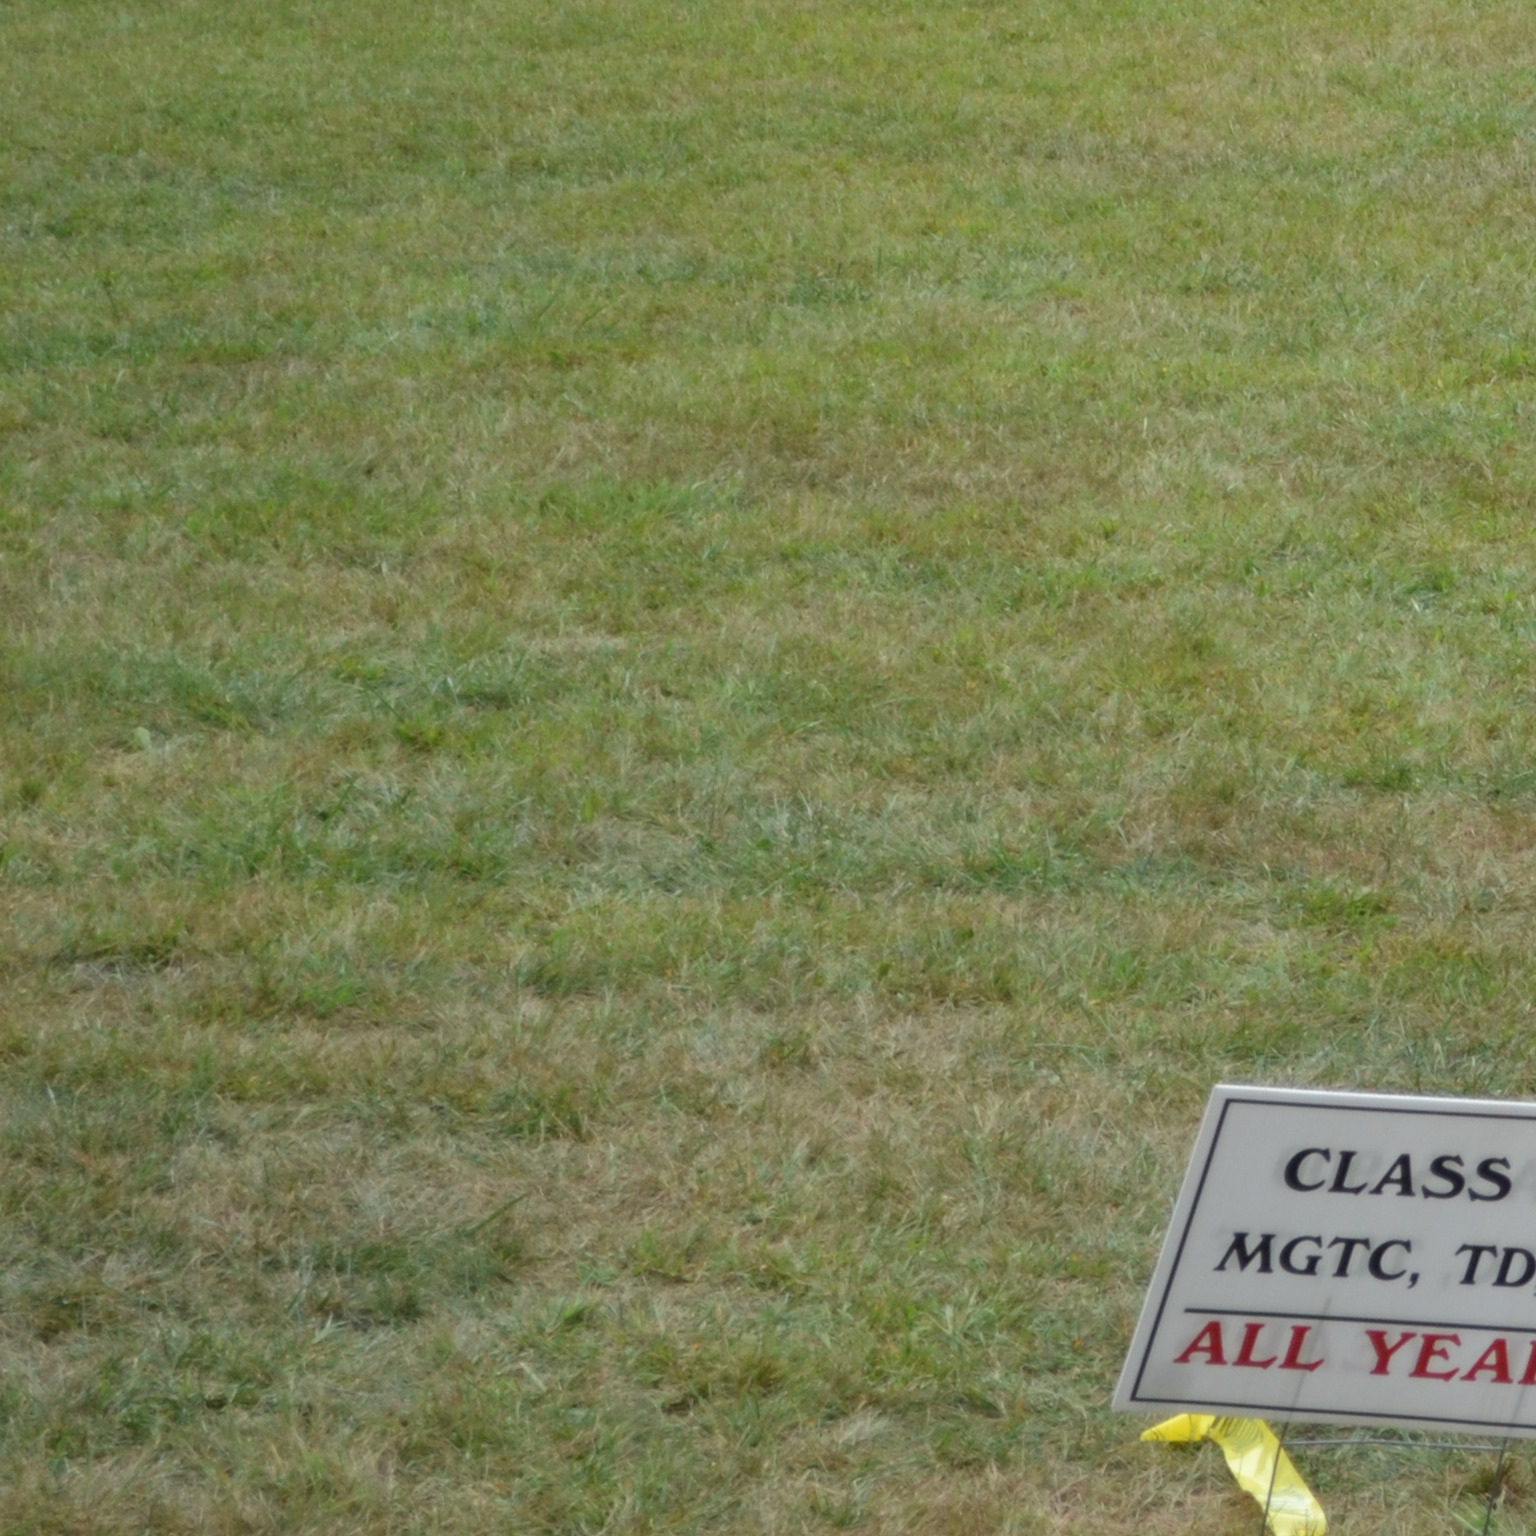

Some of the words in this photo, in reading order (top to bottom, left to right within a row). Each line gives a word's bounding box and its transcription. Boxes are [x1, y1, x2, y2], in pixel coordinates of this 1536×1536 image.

[1284, 1147, 1513, 1202] CLASS
[1213, 1232, 1421, 1290] MGTC,
[1173, 1320, 1326, 1372] ALL
